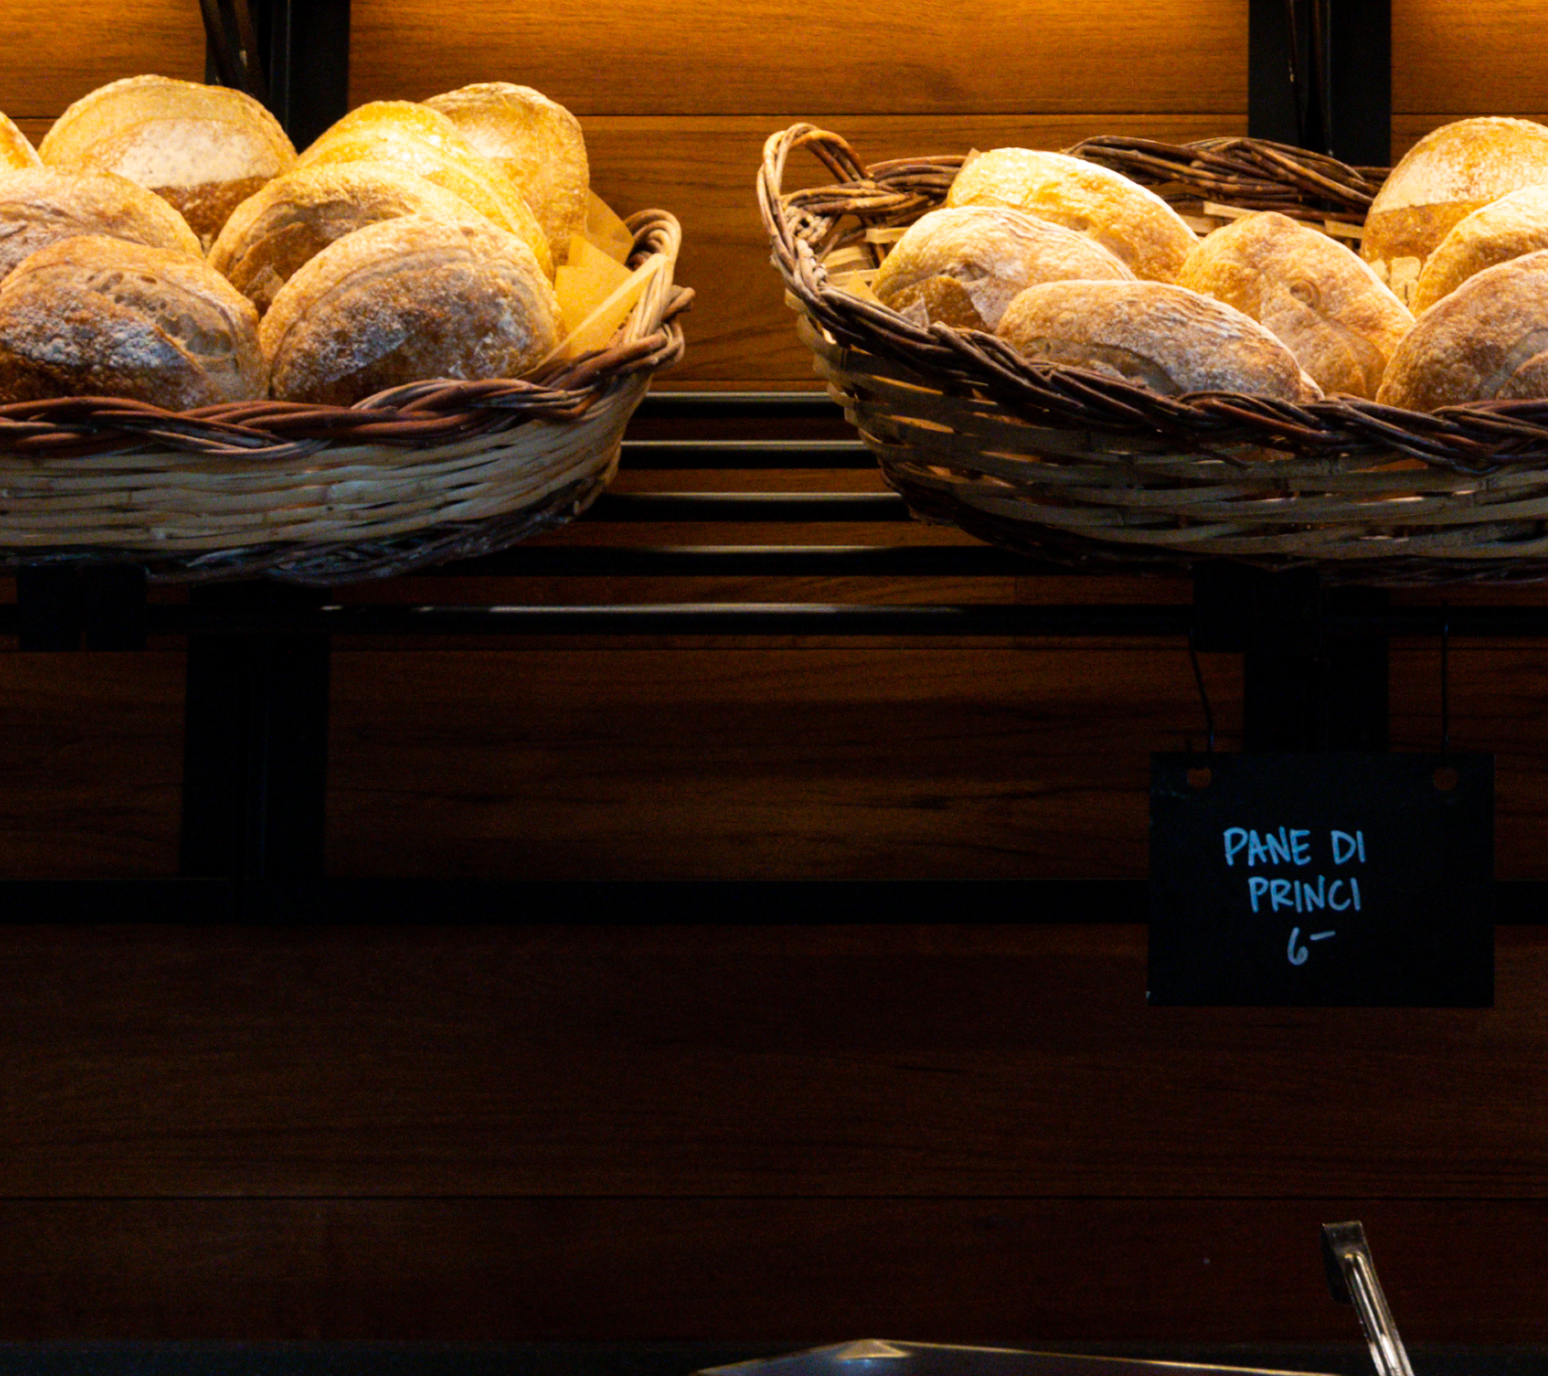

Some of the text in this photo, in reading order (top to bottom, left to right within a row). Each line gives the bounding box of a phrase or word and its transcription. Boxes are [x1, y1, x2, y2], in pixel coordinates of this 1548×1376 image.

[1222, 825, 1367, 868] PANE DI
[1247, 874, 1362, 914] PRINCI
